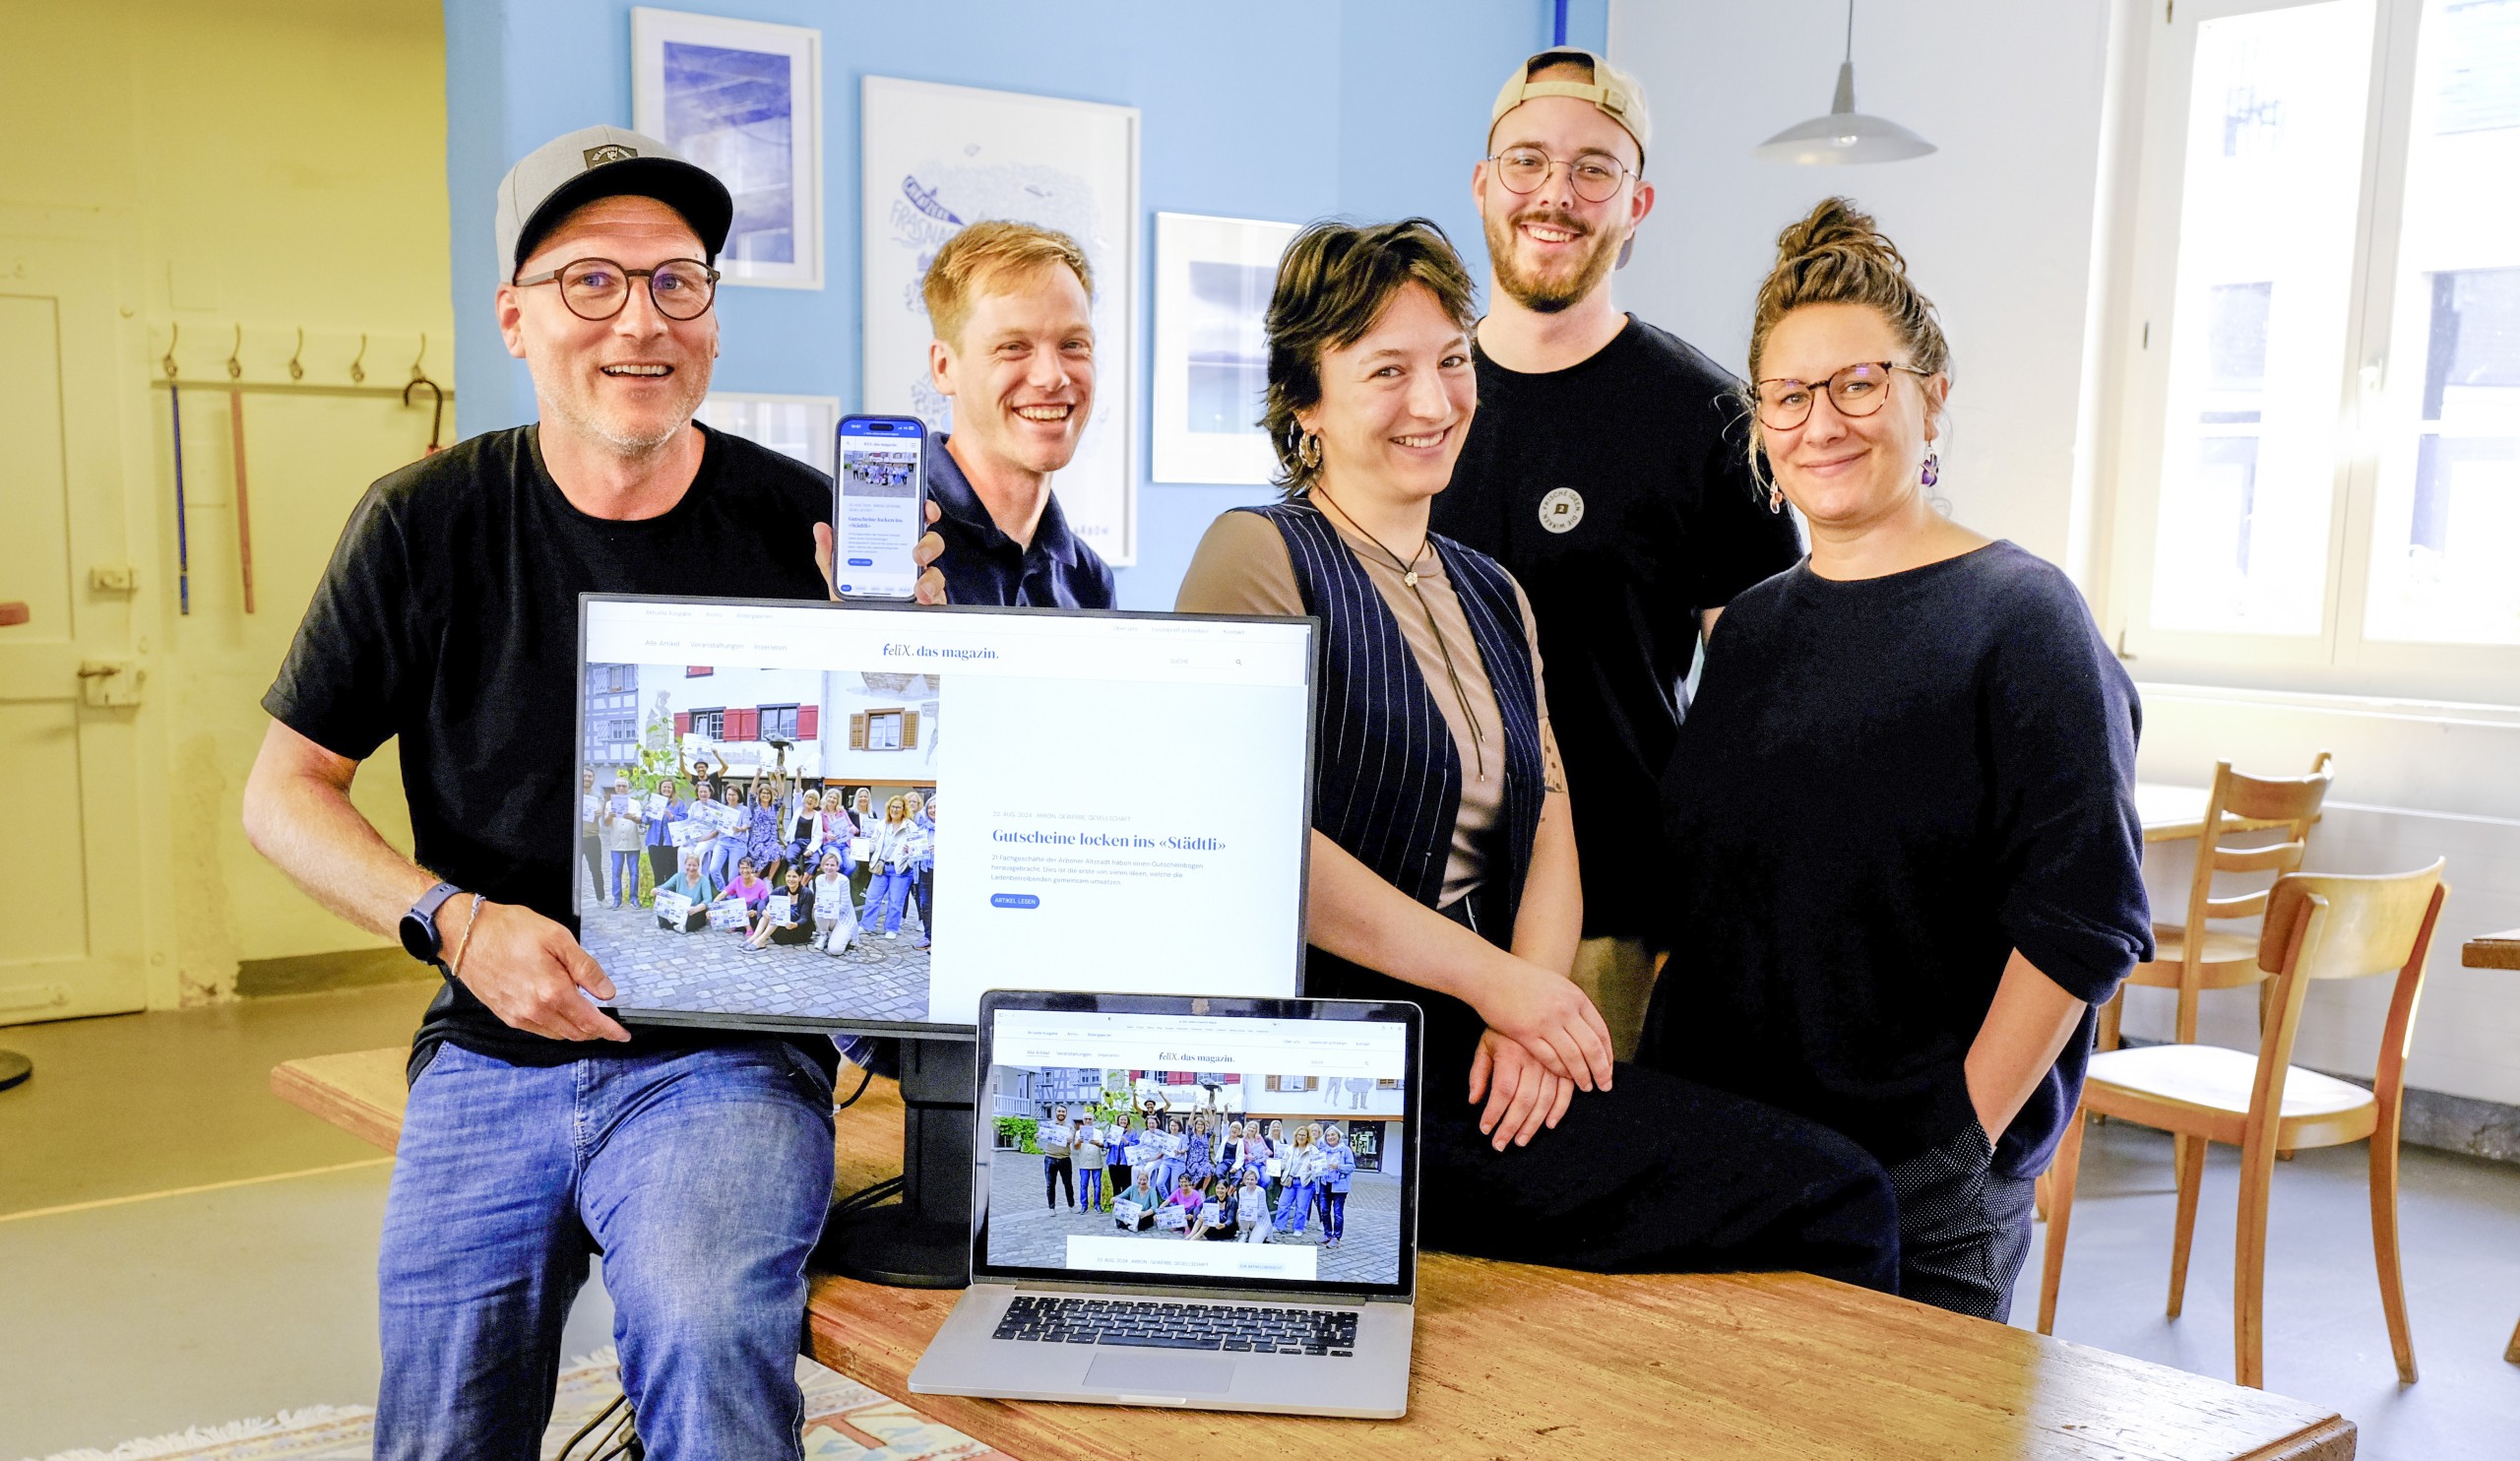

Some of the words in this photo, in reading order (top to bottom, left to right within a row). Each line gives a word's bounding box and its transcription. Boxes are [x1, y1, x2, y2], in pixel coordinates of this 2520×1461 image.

[1543, 490, 1568, 509] FRISCHE
[690, 640, 744, 652] Veranstaltungen
[916, 645, 939, 658] das
[941, 647, 999, 662] magazin.
[992, 828, 1076, 846] Gutscheine
[1080, 831, 1129, 848] locken
[1133, 834, 1156, 849] ins
[1159, 836, 1227, 851] «Städtli»
[1151, 860, 1204, 870] Gutscheinbogen
[990, 873, 1052, 884] Ladenbetreibenden
[1052, 876, 1090, 886] gemeinsam
[1180, 1052, 1196, 1062] das
[1197, 1054, 1235, 1064] magazin.
